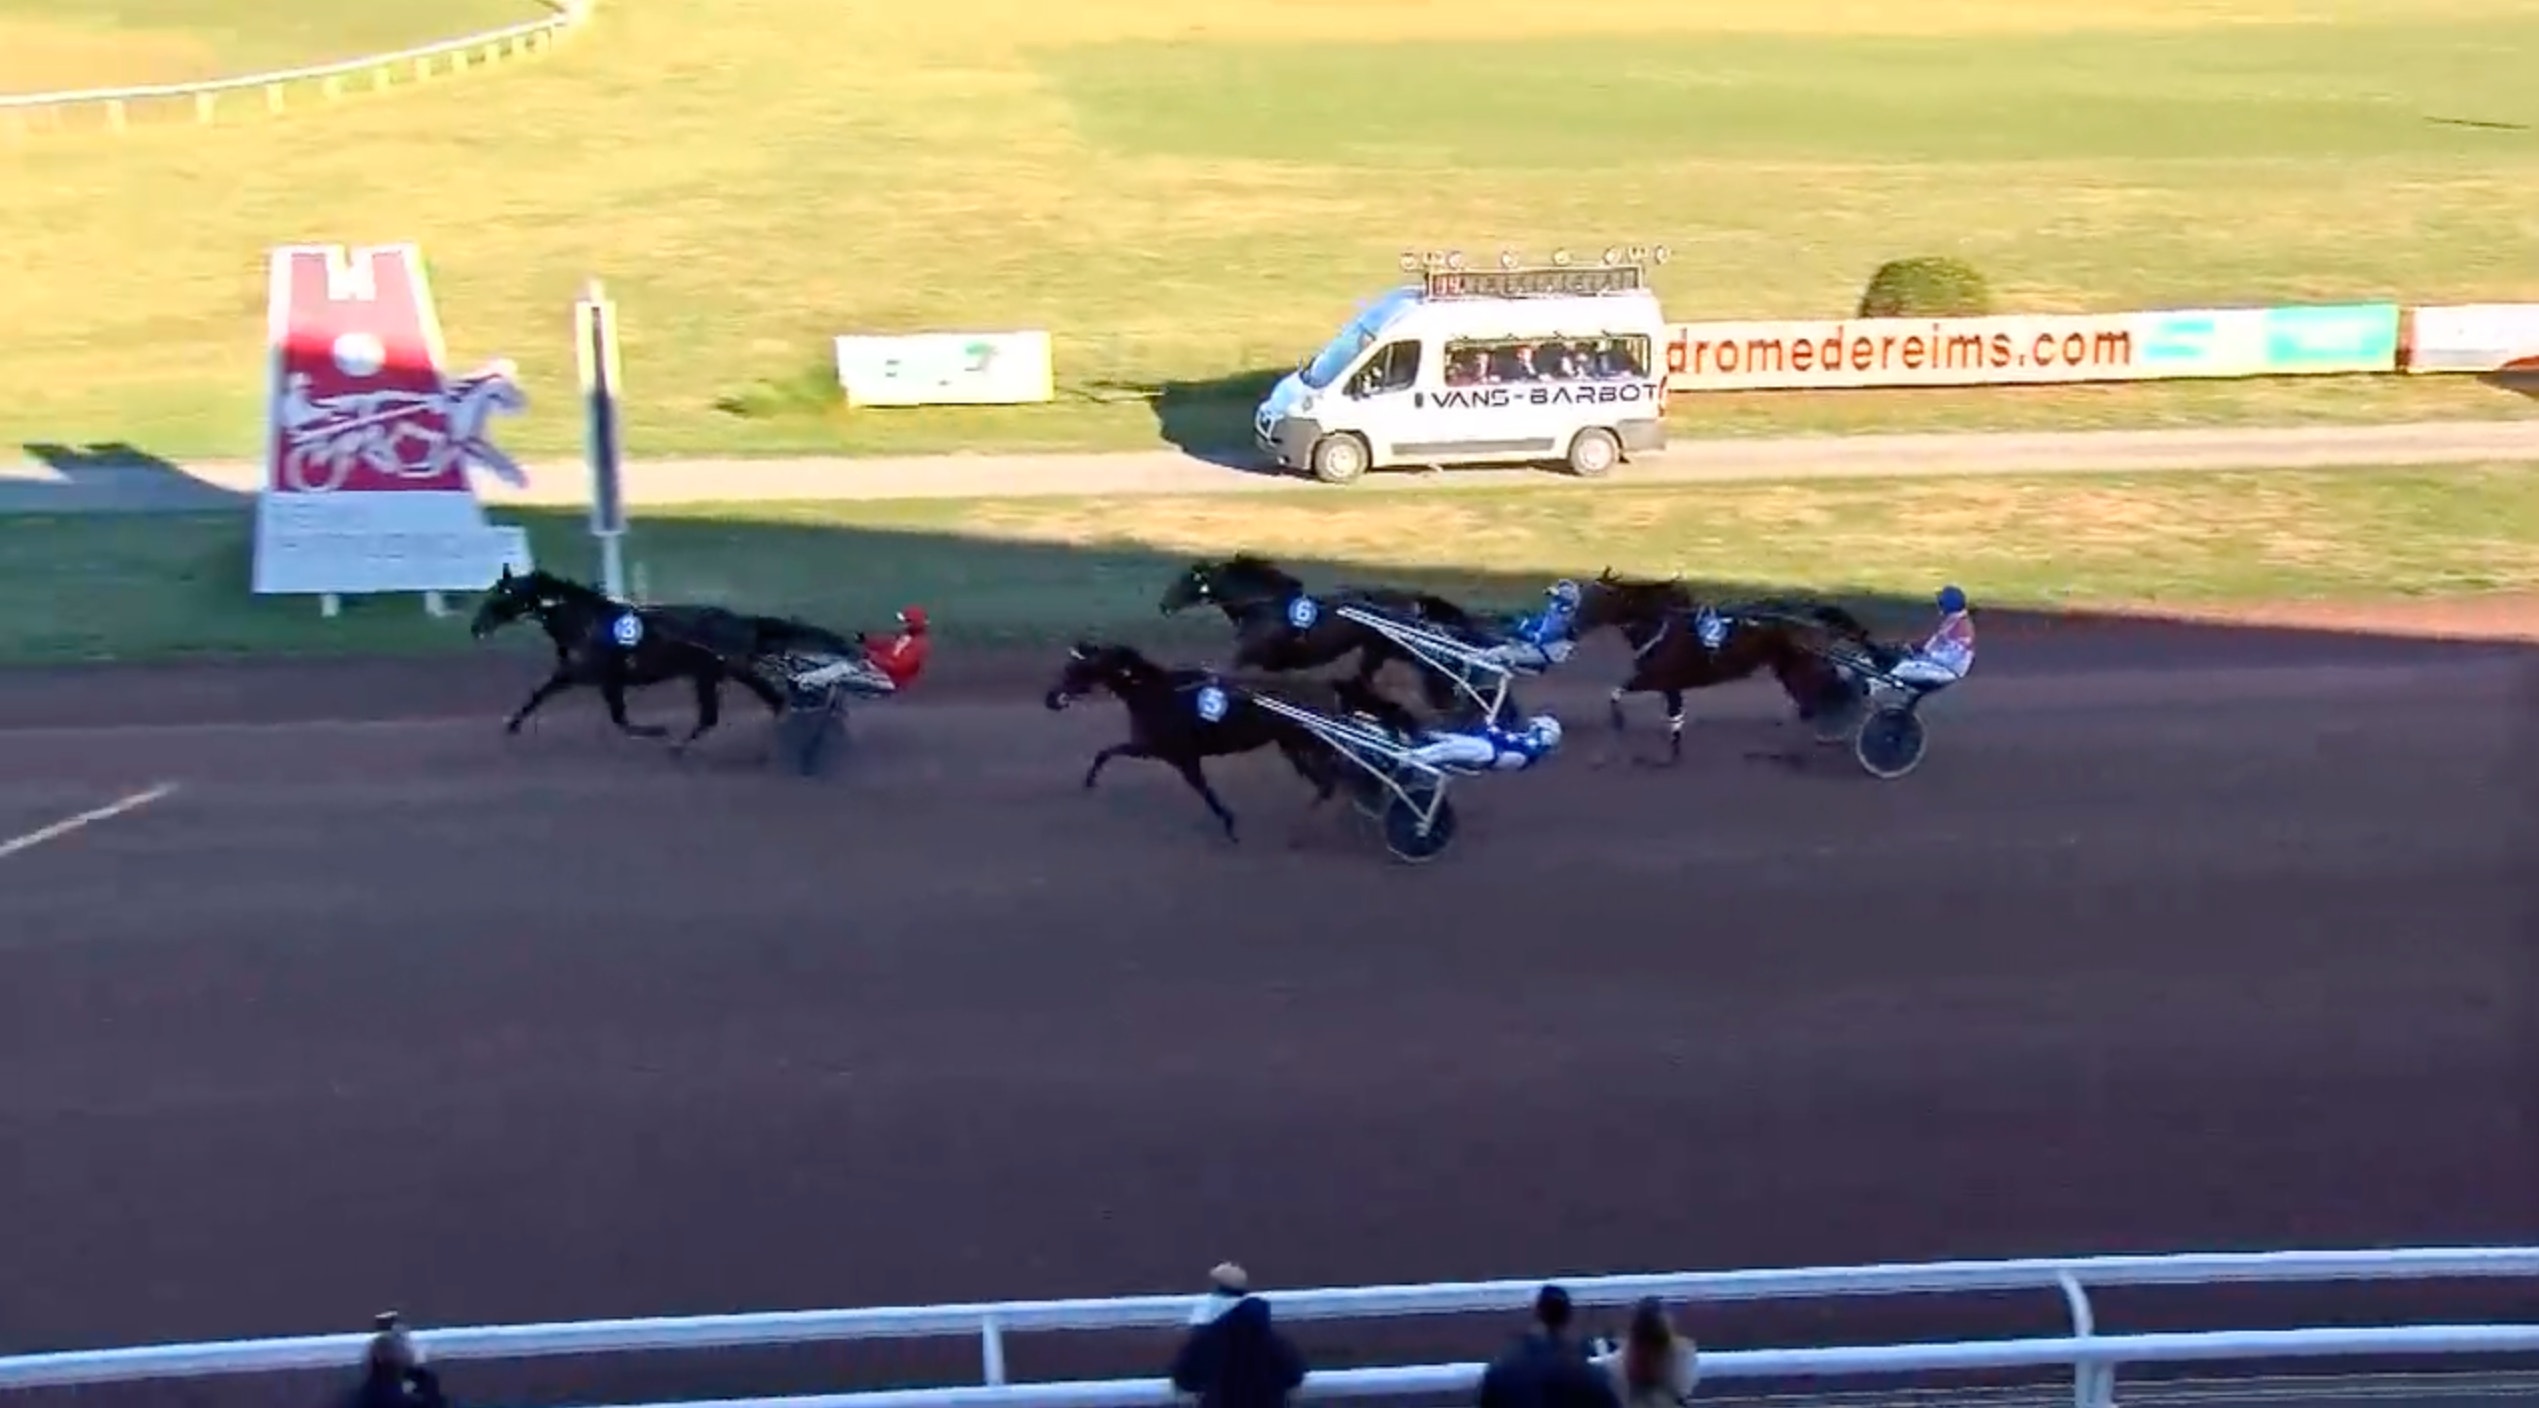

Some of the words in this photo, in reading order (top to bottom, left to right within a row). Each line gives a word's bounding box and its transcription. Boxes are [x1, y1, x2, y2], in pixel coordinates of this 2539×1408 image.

[1431, 384, 1658, 409] VANS-BARBOT
[1296, 601, 1311, 621] 6
[621, 618, 636, 638] 3
[1706, 620, 1720, 640] 2
[1204, 689, 1224, 713] 5
